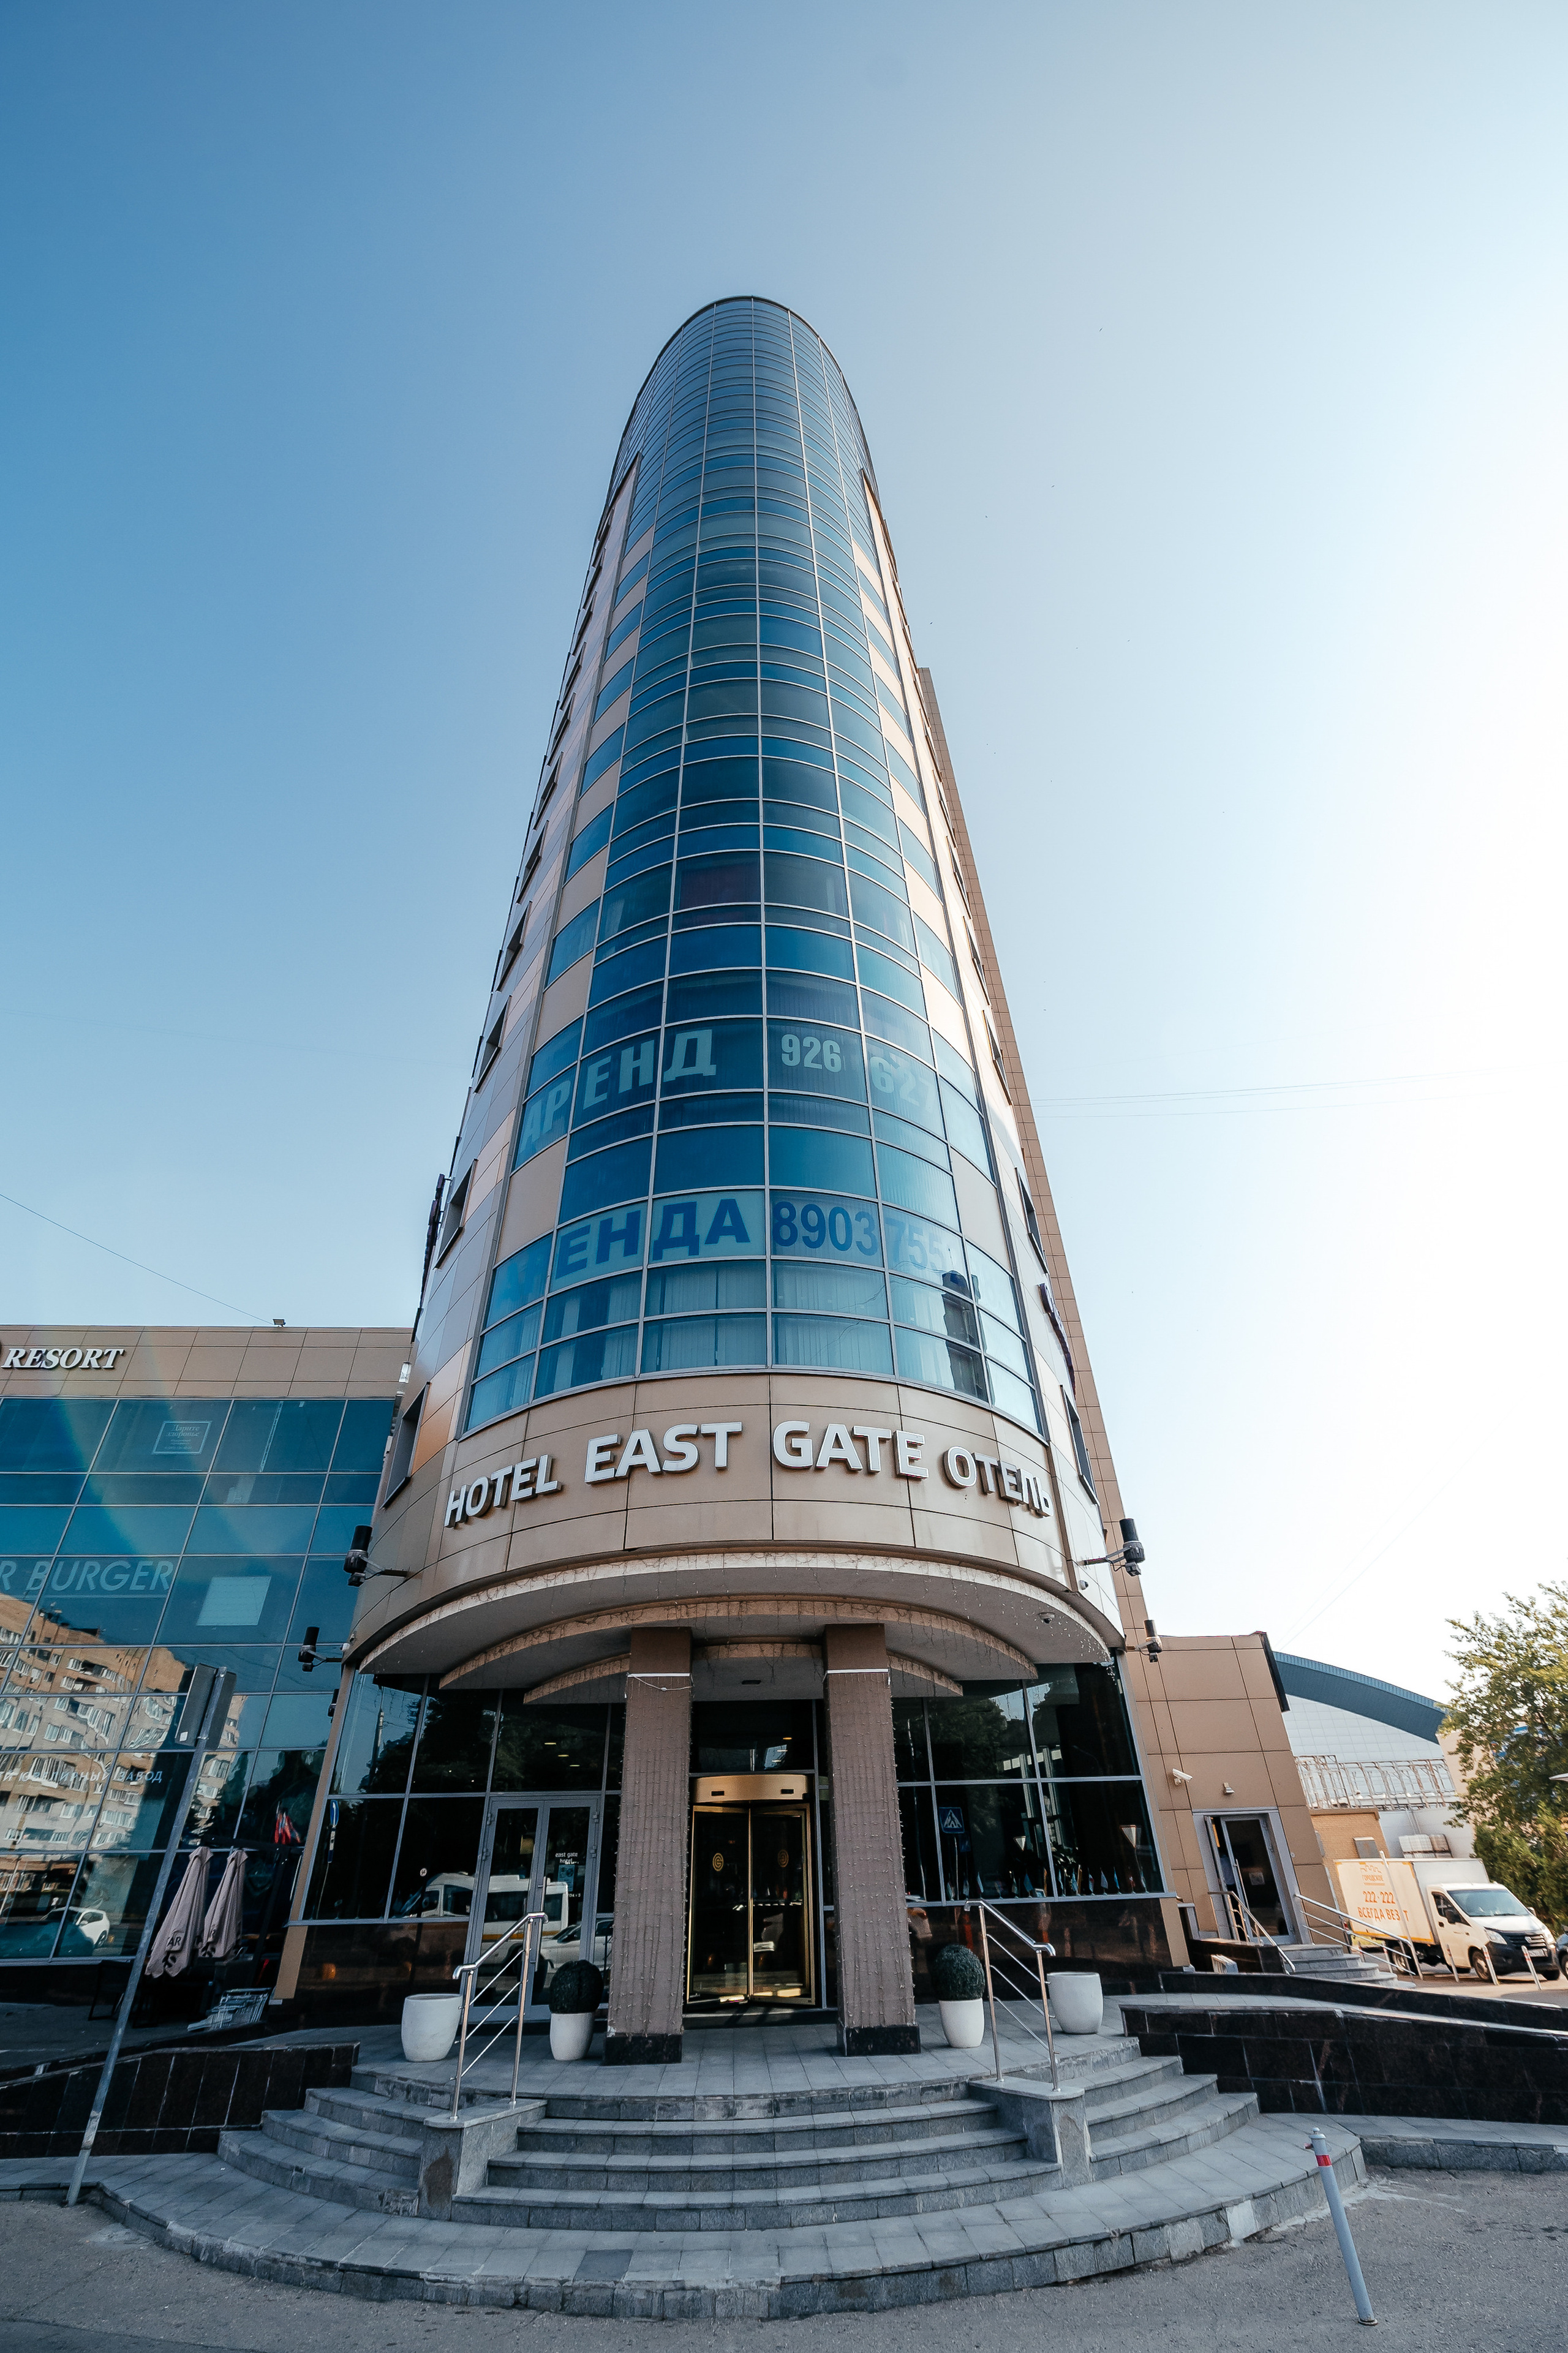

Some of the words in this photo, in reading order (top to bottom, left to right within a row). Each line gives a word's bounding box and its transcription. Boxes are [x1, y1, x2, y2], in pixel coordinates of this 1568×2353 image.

[781, 1034, 842, 1073] 926
[772, 1200, 878, 1257] 8903
[1, 1347, 125, 1369] RESORT
[443, 1453, 562, 1529] HOTEL
[584, 1421, 743, 1485] EAST
[772, 1420, 930, 1480] GATE
[943, 1445, 1054, 1518] ОТЕЛЬ
[24, 1561, 174, 1591] BURGER
[118, 1771, 163, 1783] ЗАВОД
[1357, 1907, 1385, 1922] ВСЕГДА
[1385, 1908, 1409, 1922] ВЕЗТ
